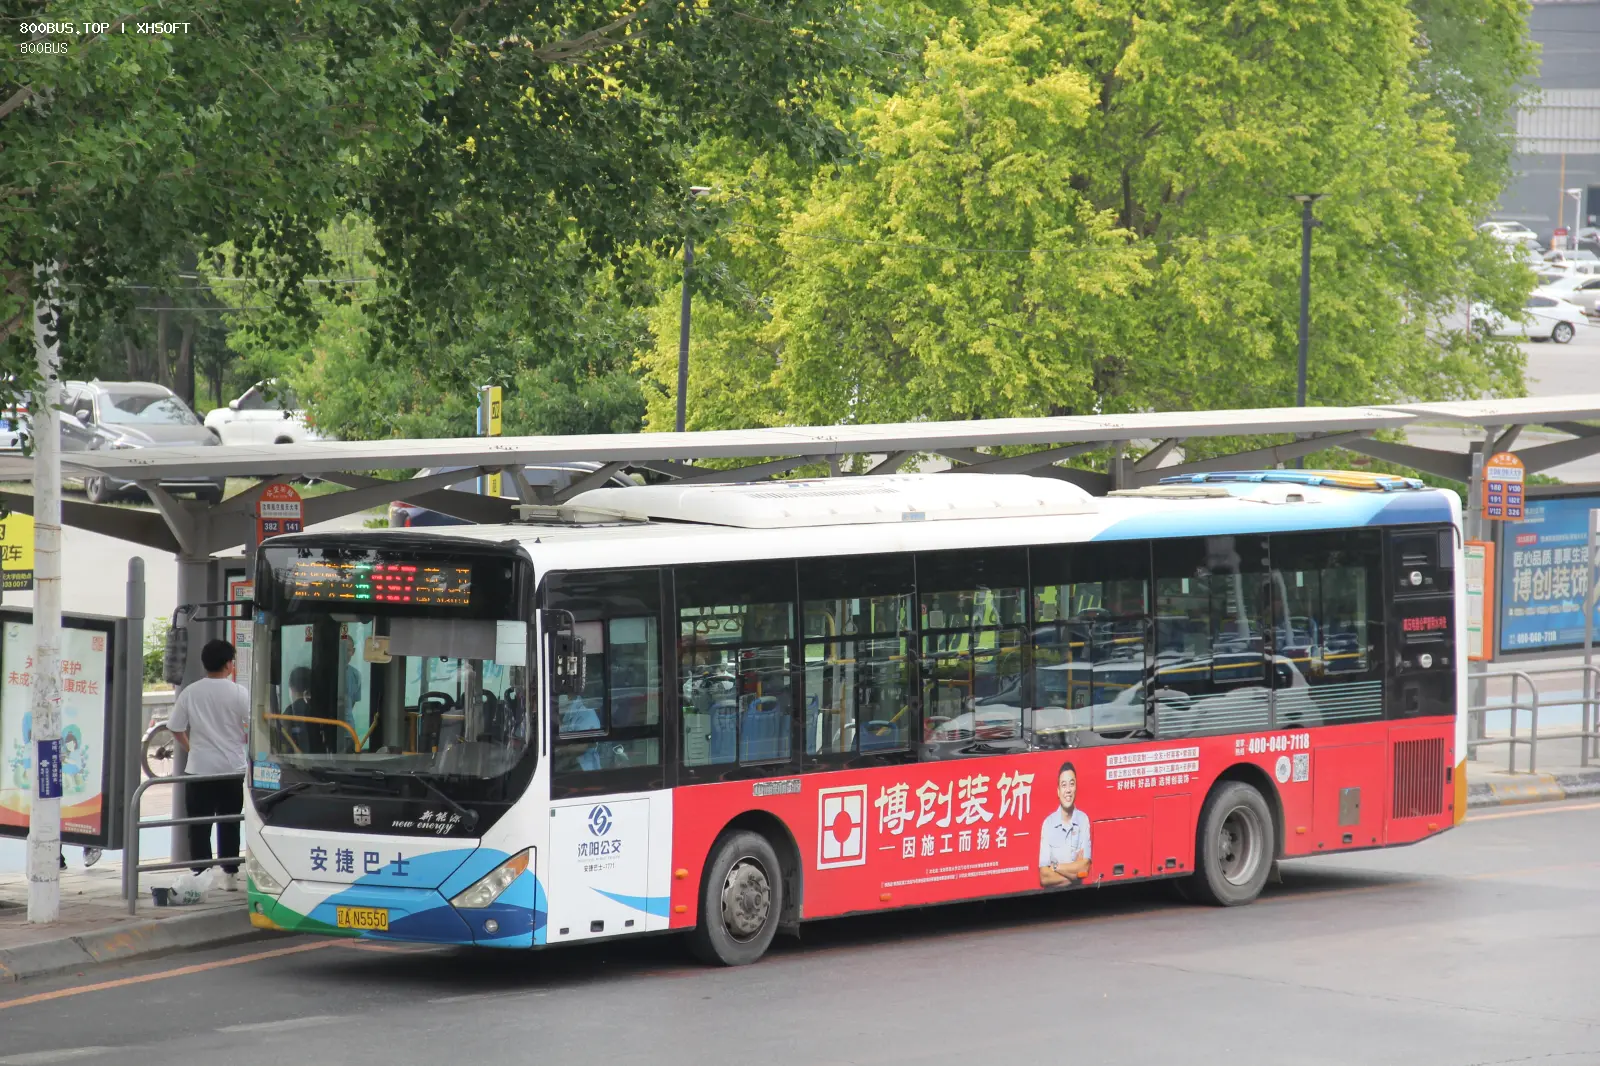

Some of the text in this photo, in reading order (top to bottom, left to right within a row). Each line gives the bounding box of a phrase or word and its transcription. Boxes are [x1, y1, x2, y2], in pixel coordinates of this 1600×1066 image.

[264, 523, 299, 531] 382 141
[1512, 565, 1589, 603] 博创装饰
[1248, 732, 1310, 755] 400-040-7118
[1117, 779, 1137, 791] 好材料
[1138, 776, 1157, 789] 好品质
[874, 769, 1036, 836] 博创装饰
[419, 809, 463, 823] 新能源
[391, 819, 455, 834] new energy
[577, 838, 622, 858] 沈阳公交
[902, 825, 1008, 860] 因施工而扬名
[309, 845, 411, 878] 安捷巴士
[353, 911, 387, 928] N5550
